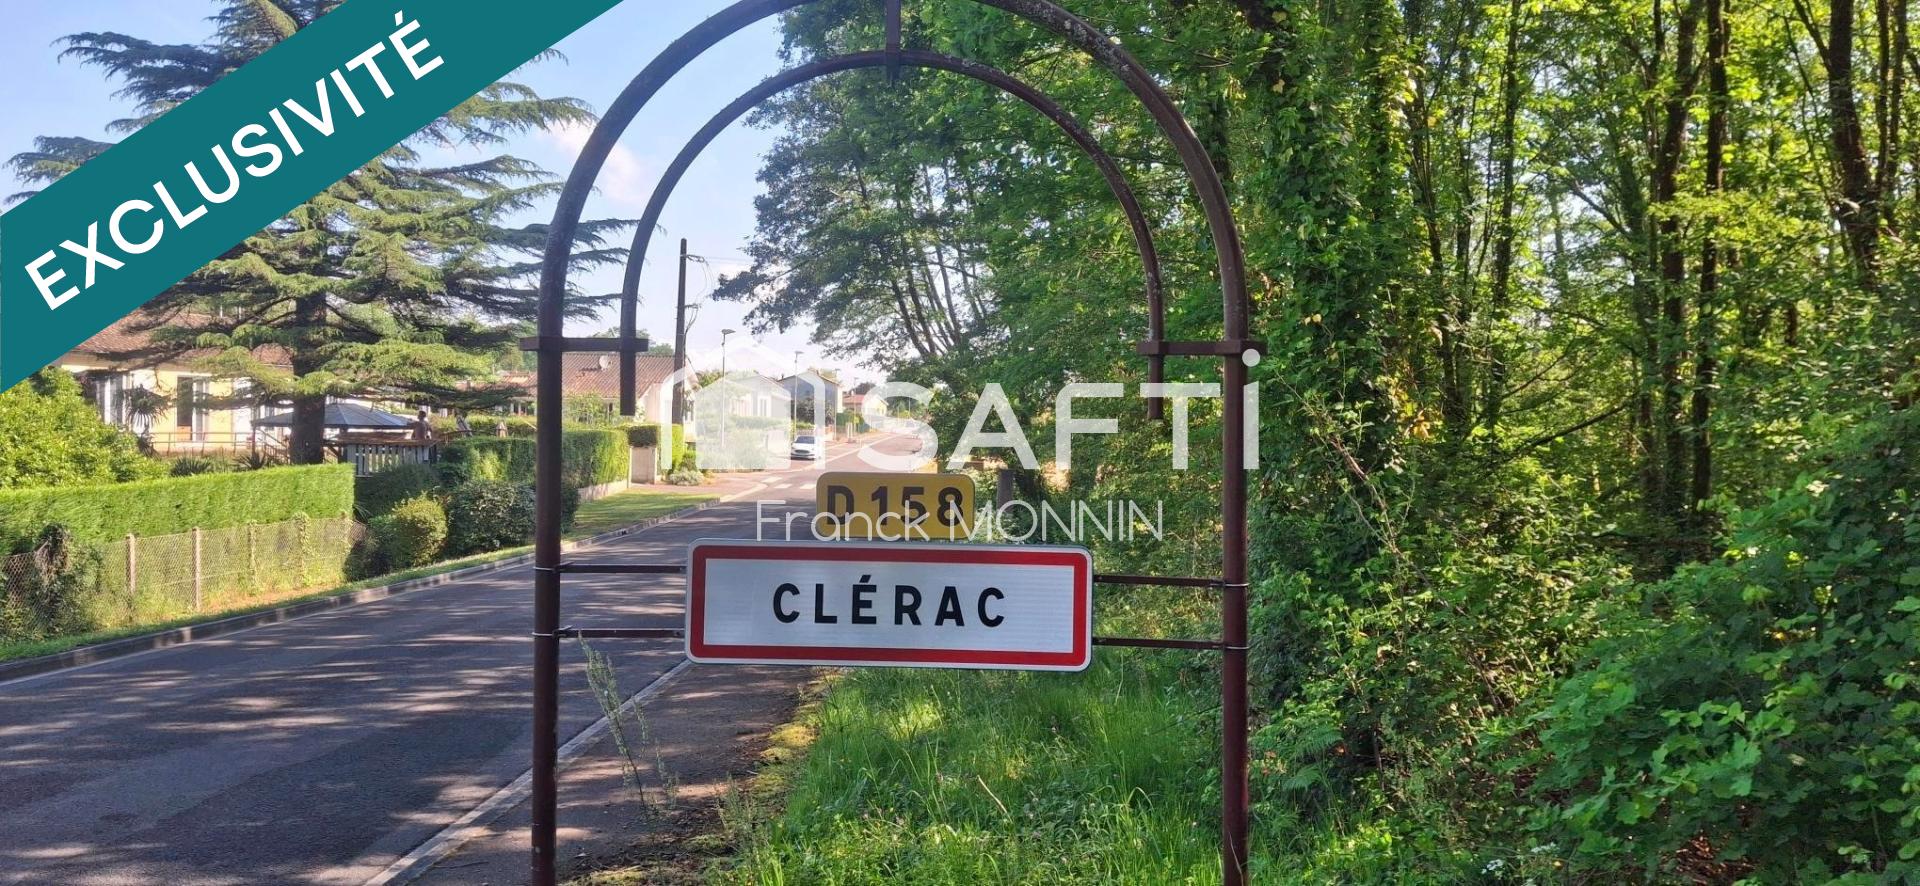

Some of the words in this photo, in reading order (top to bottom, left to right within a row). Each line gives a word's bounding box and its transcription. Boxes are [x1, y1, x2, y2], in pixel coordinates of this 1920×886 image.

[826, 485, 855, 526] D
[871, 486, 965, 527] 158
[772, 574, 1006, 628] CLÉRAC
